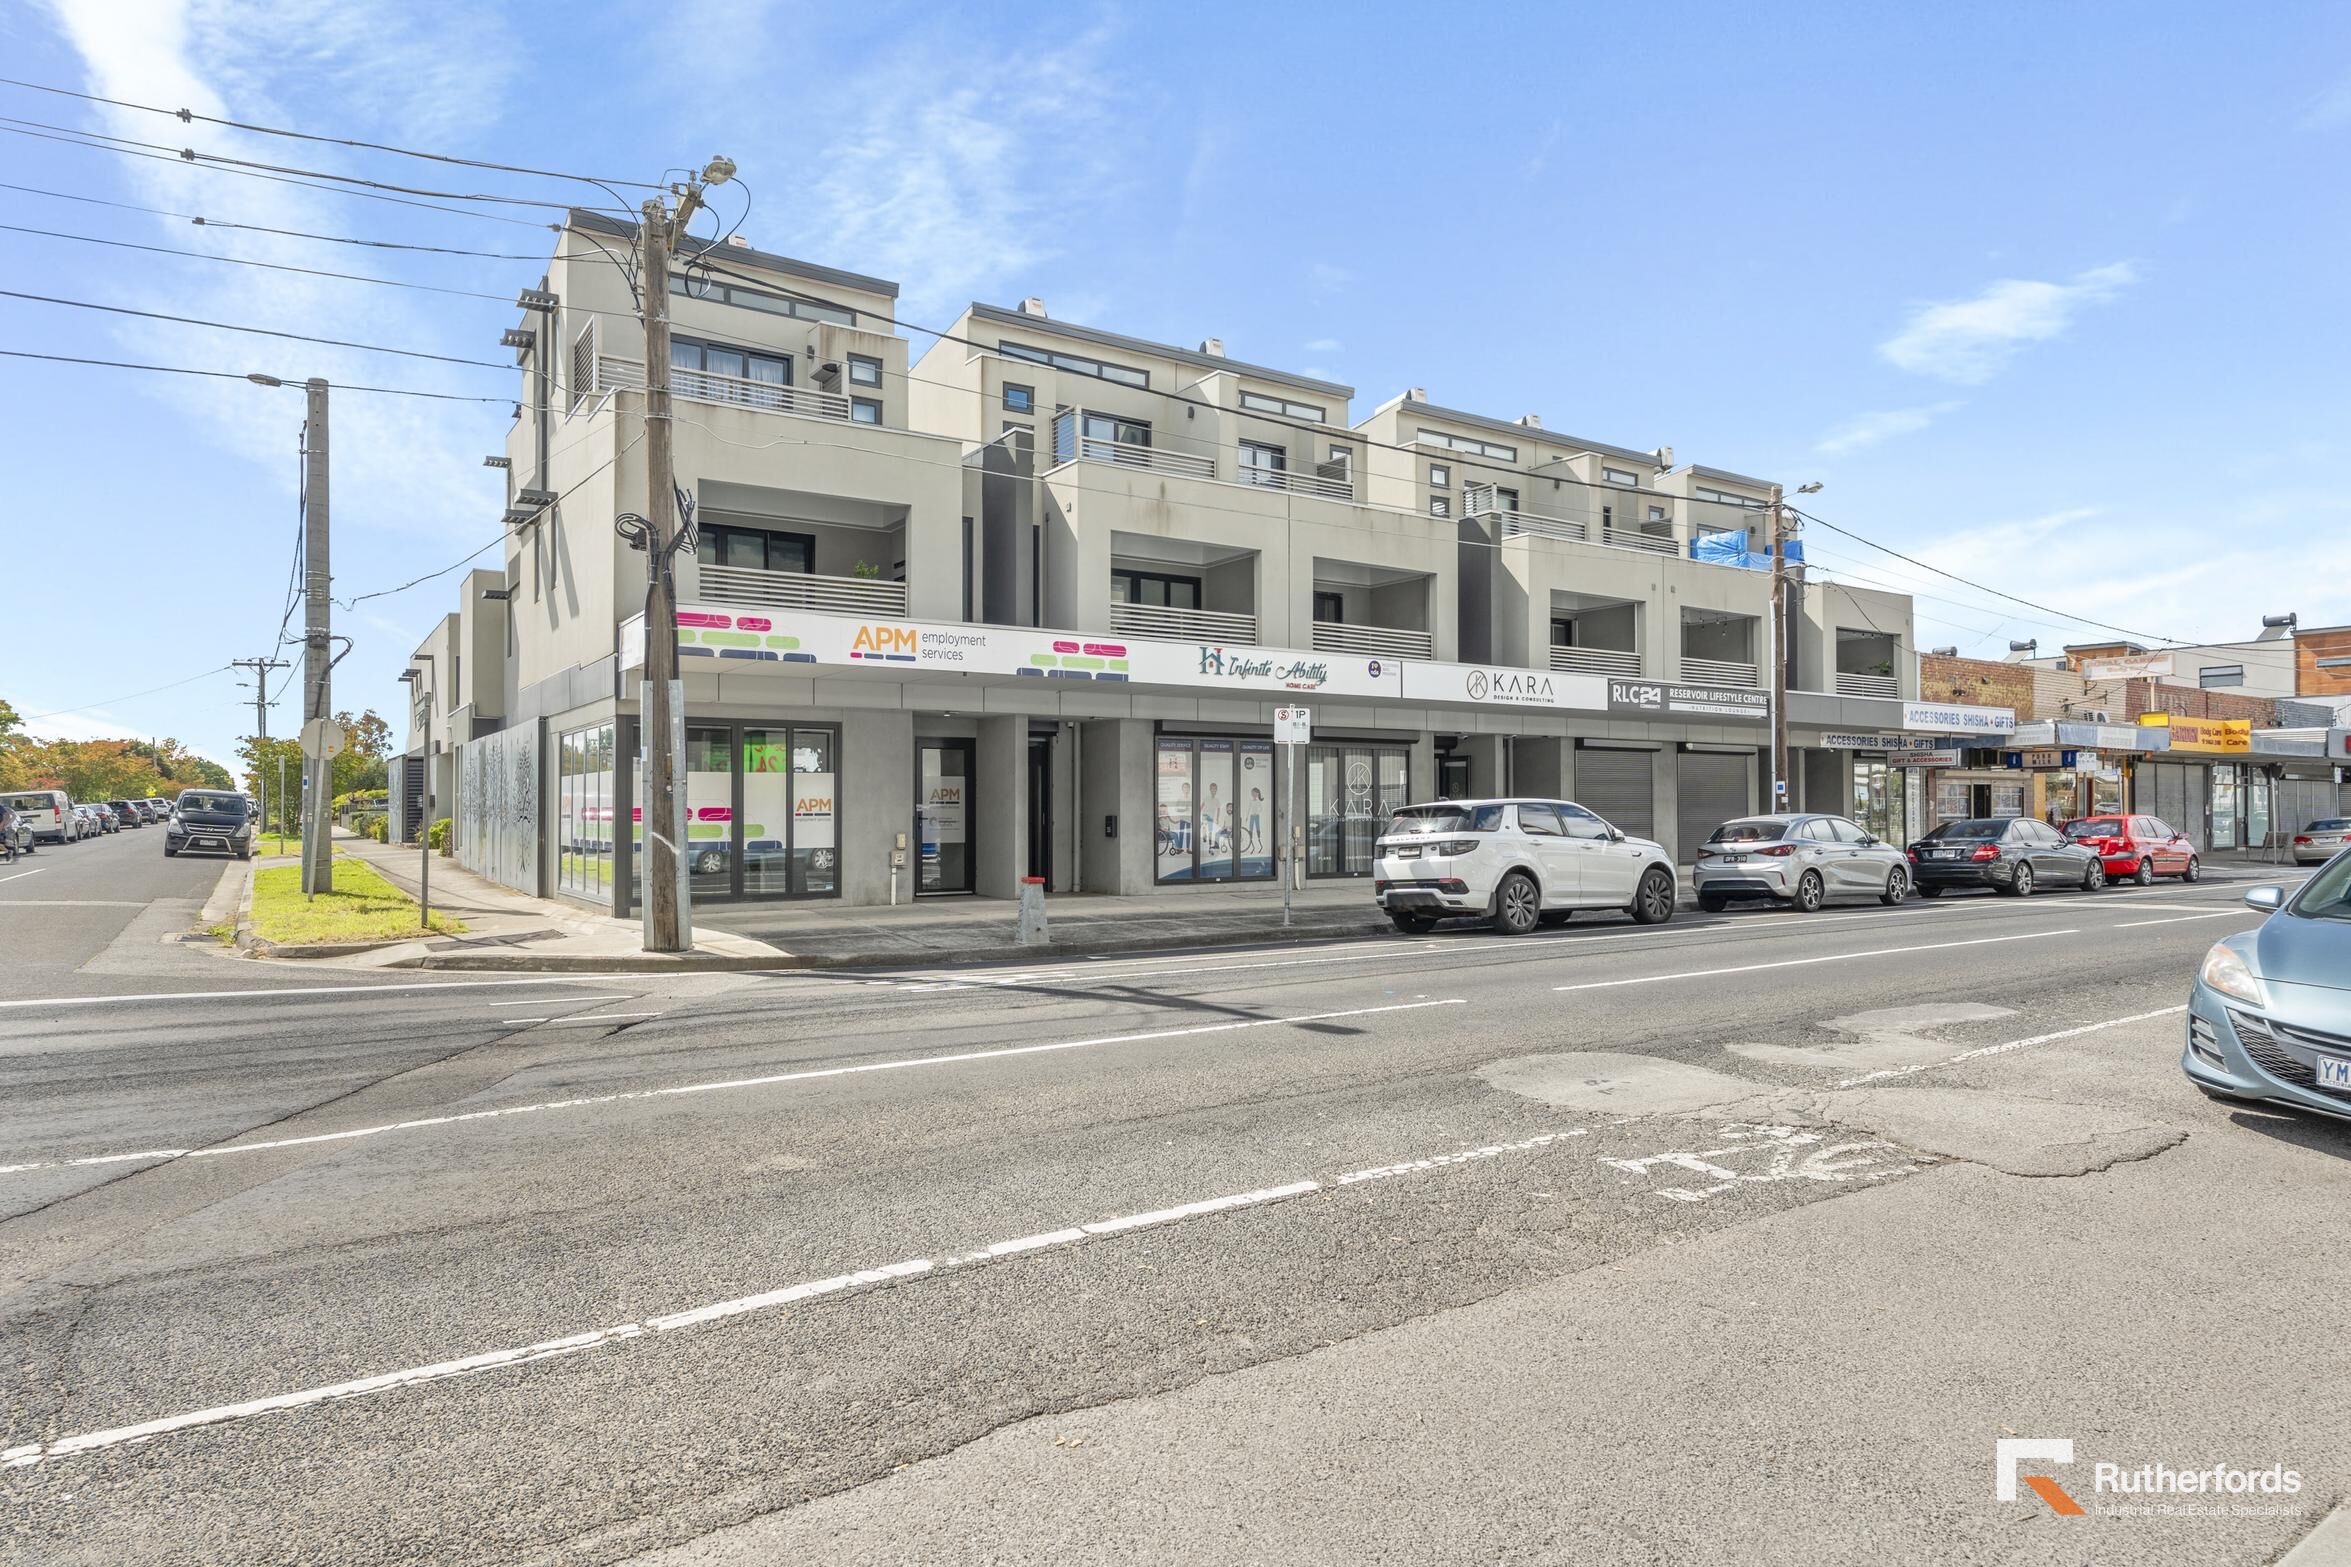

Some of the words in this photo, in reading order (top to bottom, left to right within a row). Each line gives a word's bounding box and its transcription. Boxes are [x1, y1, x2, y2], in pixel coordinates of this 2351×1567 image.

[852, 626, 917, 653] APM
[922, 632, 986, 647] employment
[922, 648, 964, 661] services
[1228, 656, 1273, 680] Infinite
[1276, 661, 1328, 686] Ability
[1494, 673, 1554, 696] KARA
[1669, 688, 1708, 700] RESERVOIR
[1710, 692, 1742, 702] LIFESTYLE
[1743, 694, 1768, 704] CENTRE
[1296, 710, 1306, 719] 1P
[1909, 710, 1960, 726] ACCESSORIES
[1963, 714, 1989, 728] SHISHA
[1994, 716, 2014, 729] GIFTS
[1826, 735, 1879, 746] ACCESSORIES
[1882, 737, 1908, 748] SHISHA
[1914, 739, 1934, 749] GIFTS
[930, 788, 960, 800] APM
[796, 798, 832, 812] APM
[1328, 798, 1391, 816] KARA
